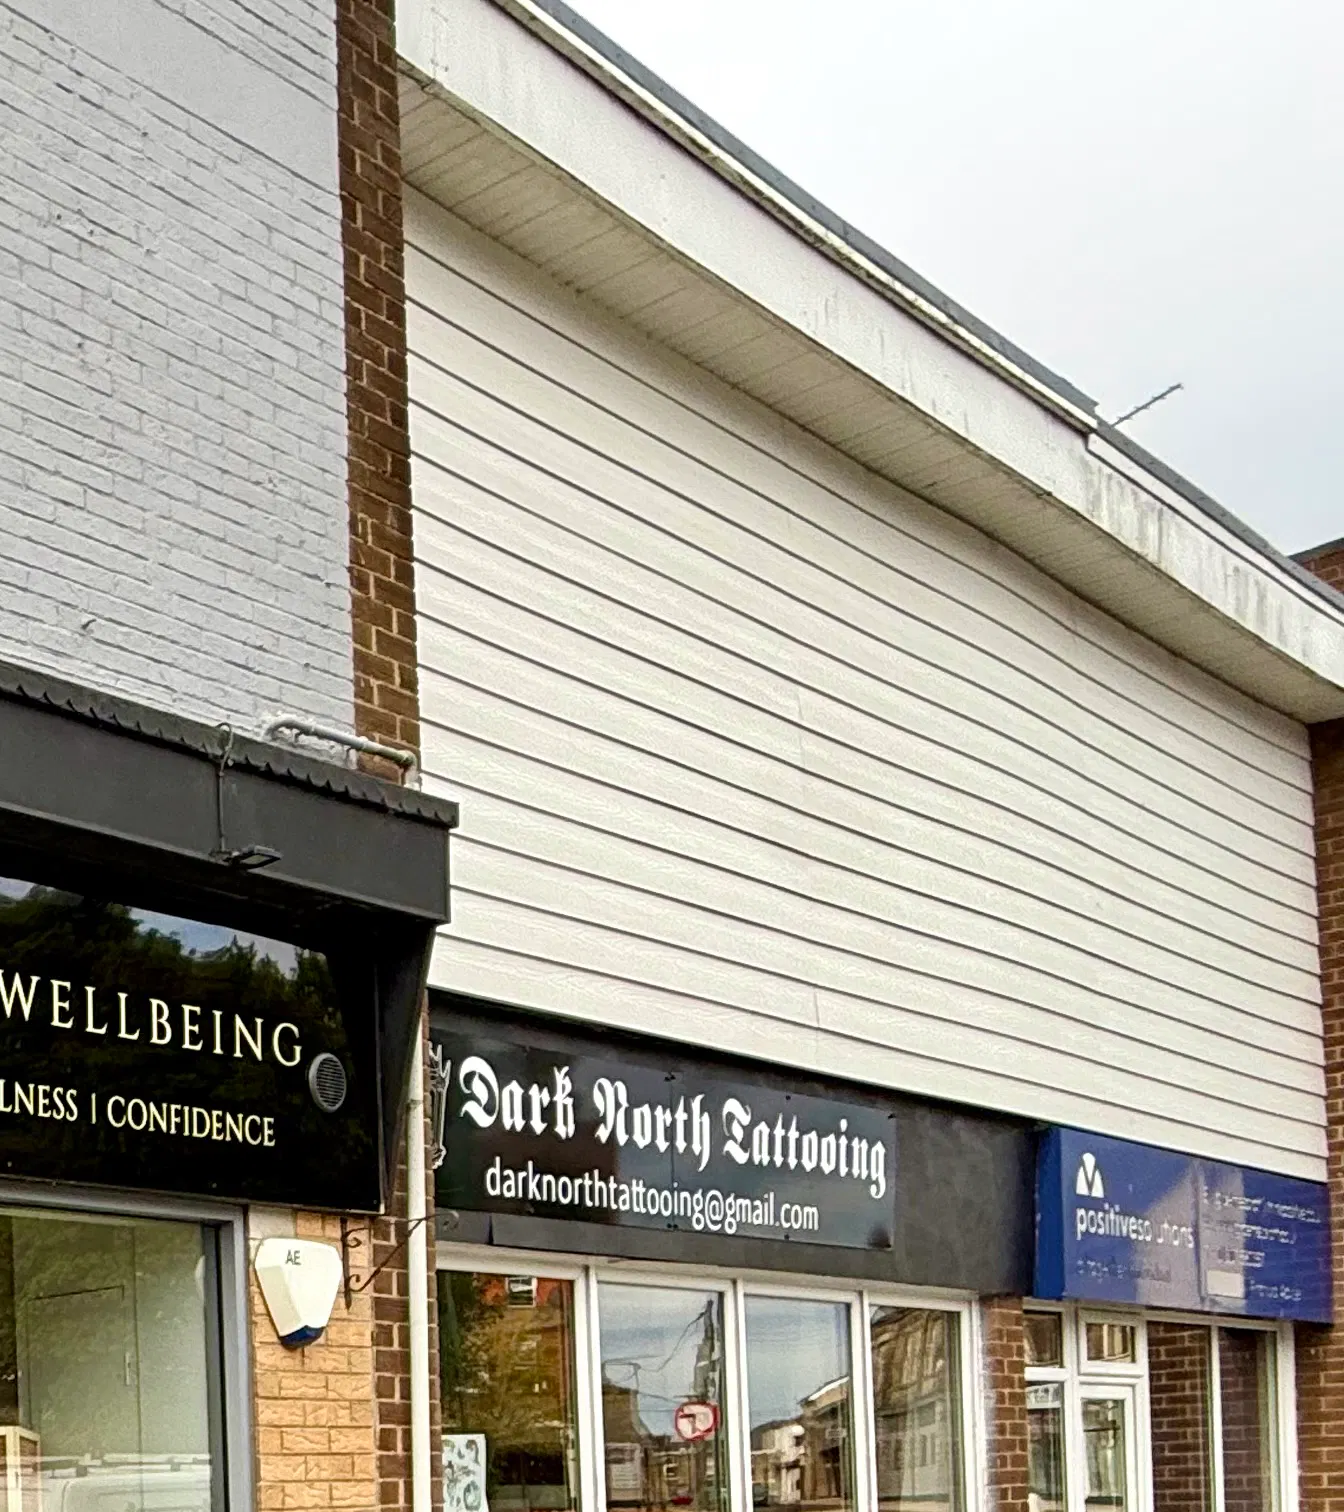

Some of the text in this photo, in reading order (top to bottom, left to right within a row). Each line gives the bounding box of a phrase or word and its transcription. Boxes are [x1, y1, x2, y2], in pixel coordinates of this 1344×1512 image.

[107, 1095, 276, 1148] CONFIDENCE
[458, 1055, 887, 1200] Dark North Tattooing
[485, 1156, 819, 1235] darknorthtattooing@gmail.com
